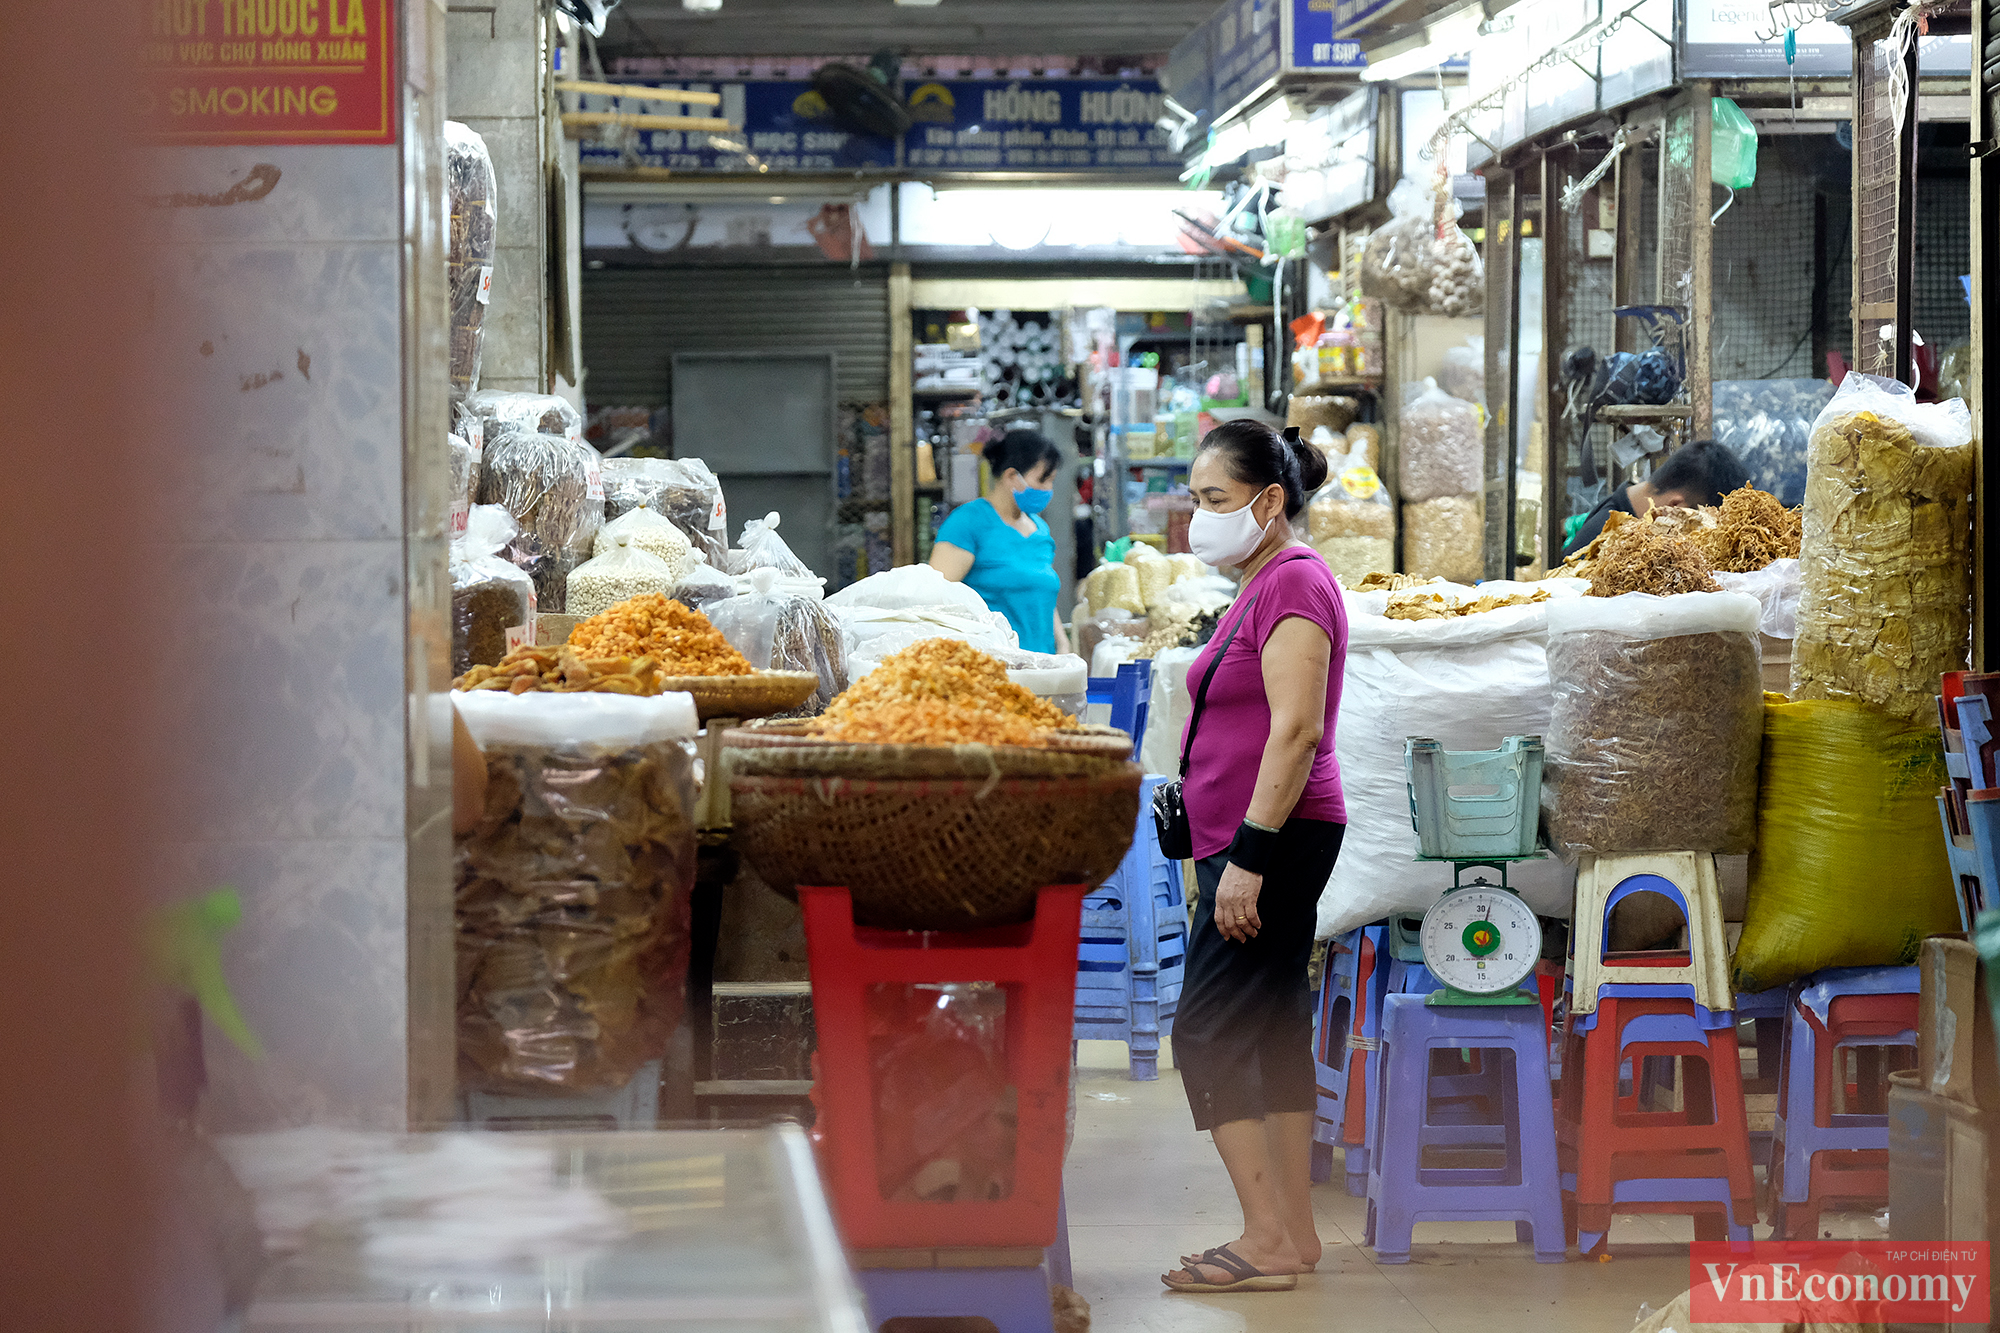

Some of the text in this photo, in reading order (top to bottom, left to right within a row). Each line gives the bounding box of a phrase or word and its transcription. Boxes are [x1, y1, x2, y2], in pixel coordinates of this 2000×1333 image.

[1711, 8, 1765, 25] Legend
[220, 41, 256, 66] CHỢ
[317, 38, 367, 61] XUÂN
[169, 86, 339, 115] SMOKING
[1476, 905, 1486, 913] 30
[1444, 922, 1454, 930] 25
[1511, 921, 1517, 929] 5
[1445, 954, 1456, 962] 20
[1504, 953, 1514, 961] 10
